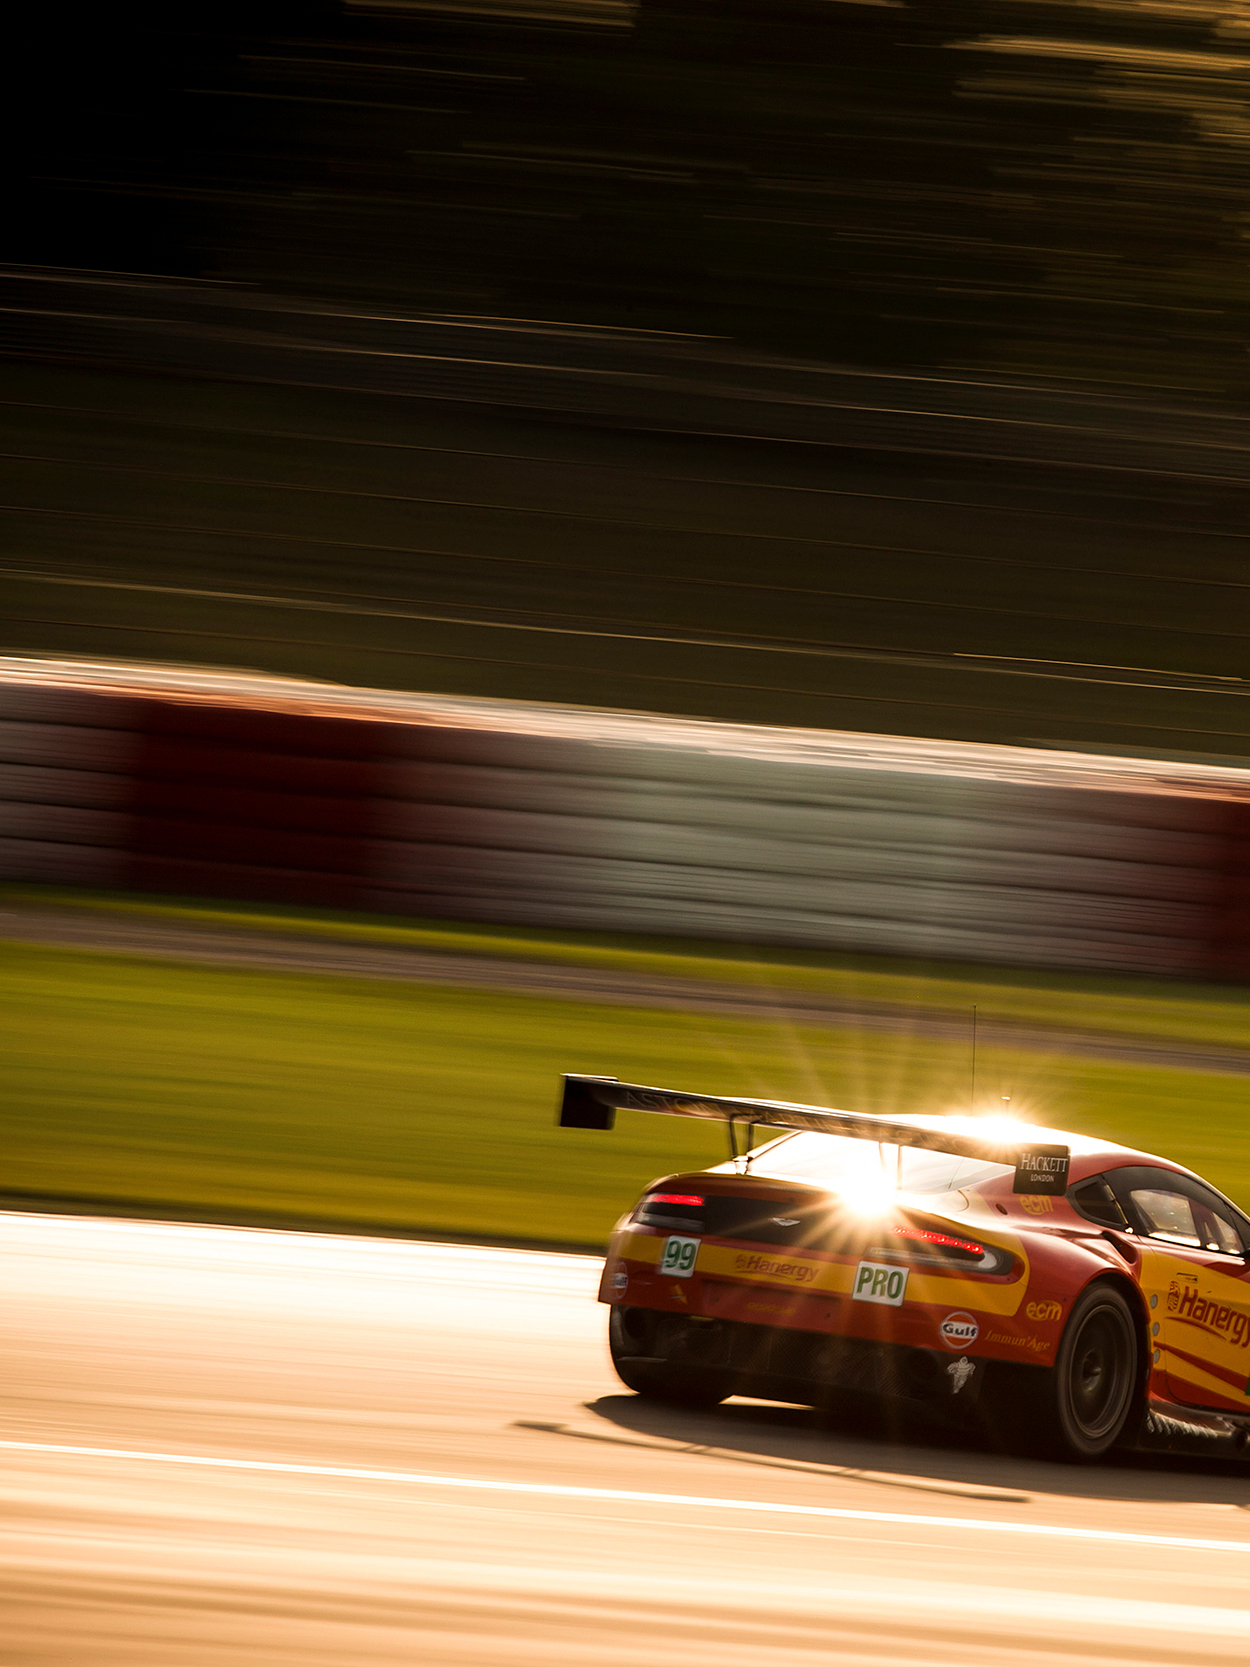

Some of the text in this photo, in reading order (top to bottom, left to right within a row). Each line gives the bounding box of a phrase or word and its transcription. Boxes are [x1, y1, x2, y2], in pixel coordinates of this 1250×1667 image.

[1020, 1153, 1068, 1172] HACKETT
[1030, 1173, 1055, 1182] LONDON
[665, 1240, 697, 1270] 99
[746, 1255, 820, 1282] Hanergy
[857, 1266, 904, 1299] PRO
[1026, 1300, 1062, 1321] ecm
[942, 1322, 978, 1337] Gulf
